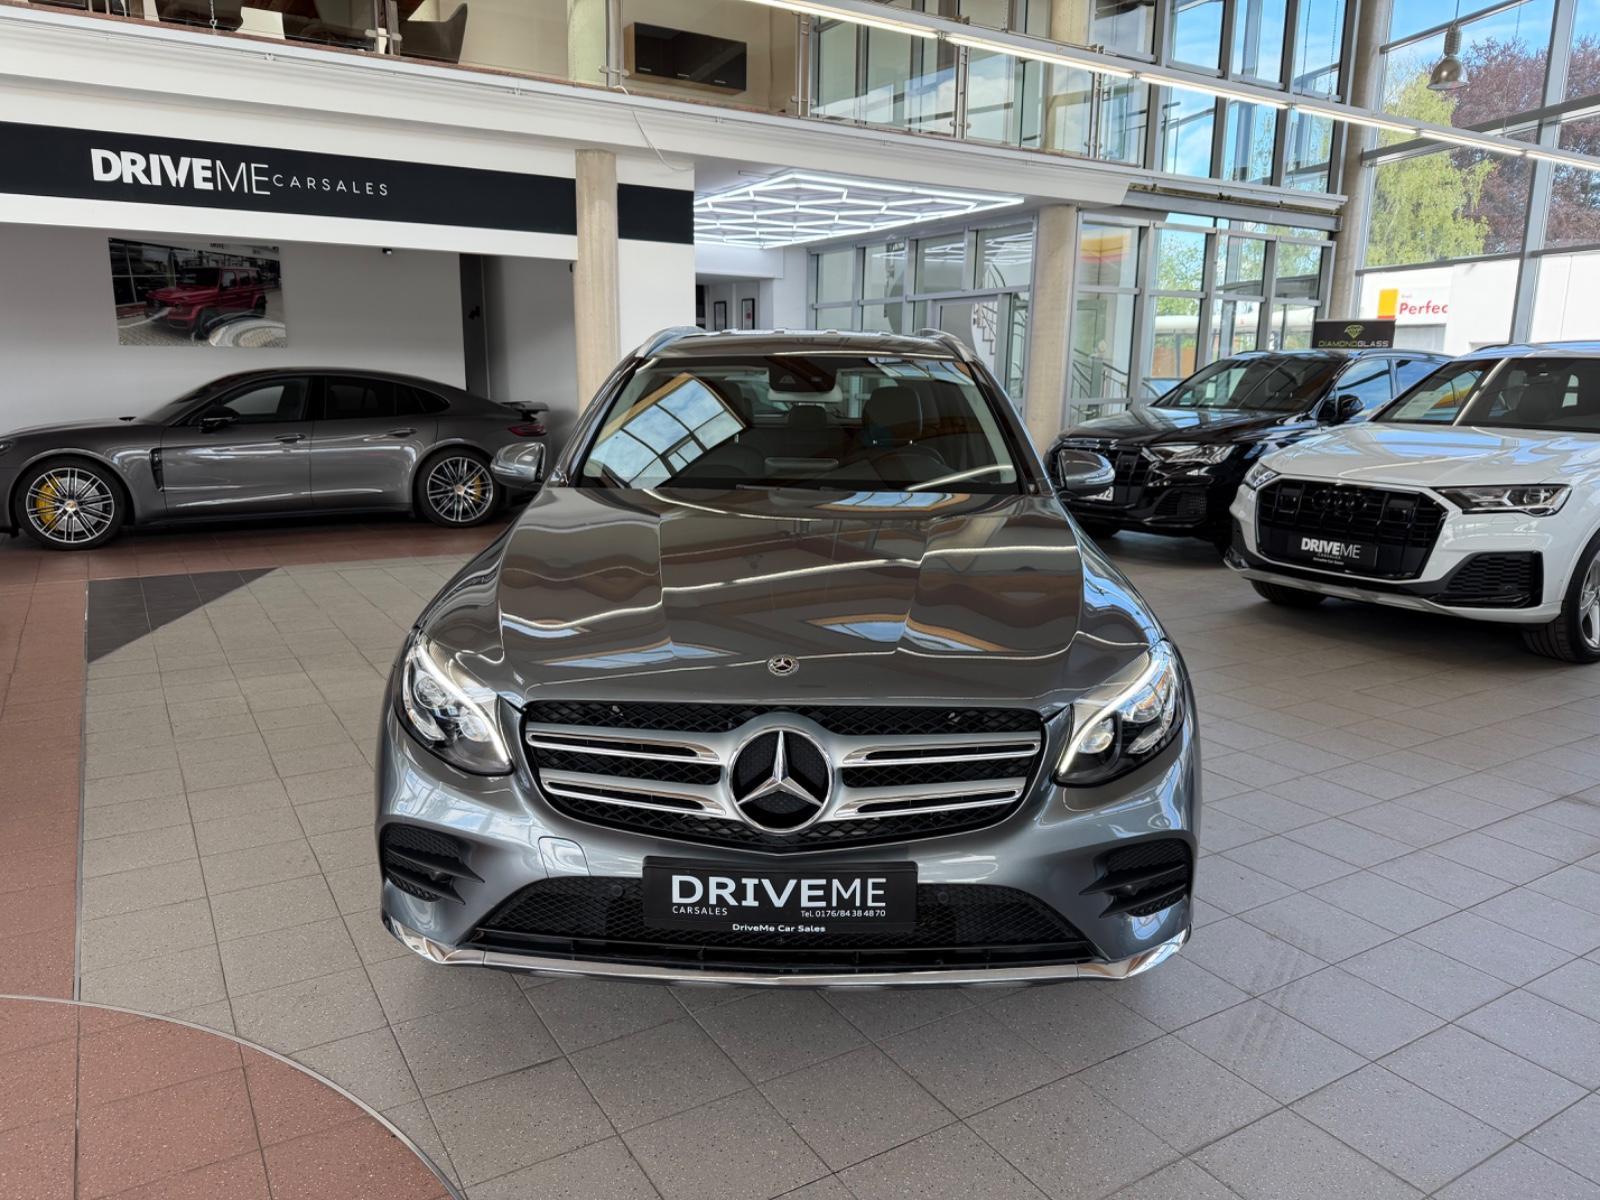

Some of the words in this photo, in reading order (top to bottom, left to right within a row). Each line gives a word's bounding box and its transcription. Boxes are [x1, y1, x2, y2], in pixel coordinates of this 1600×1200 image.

[272, 174, 388, 196] CARSALES
[1301, 537, 1361, 559] DRIVEME
[671, 875, 887, 908] DRIVEME
[672, 906, 728, 916] CARSALES
[732, 923, 775, 932] DriveMe
[777, 925, 795, 933] Car
[798, 925, 826, 933] Sales
